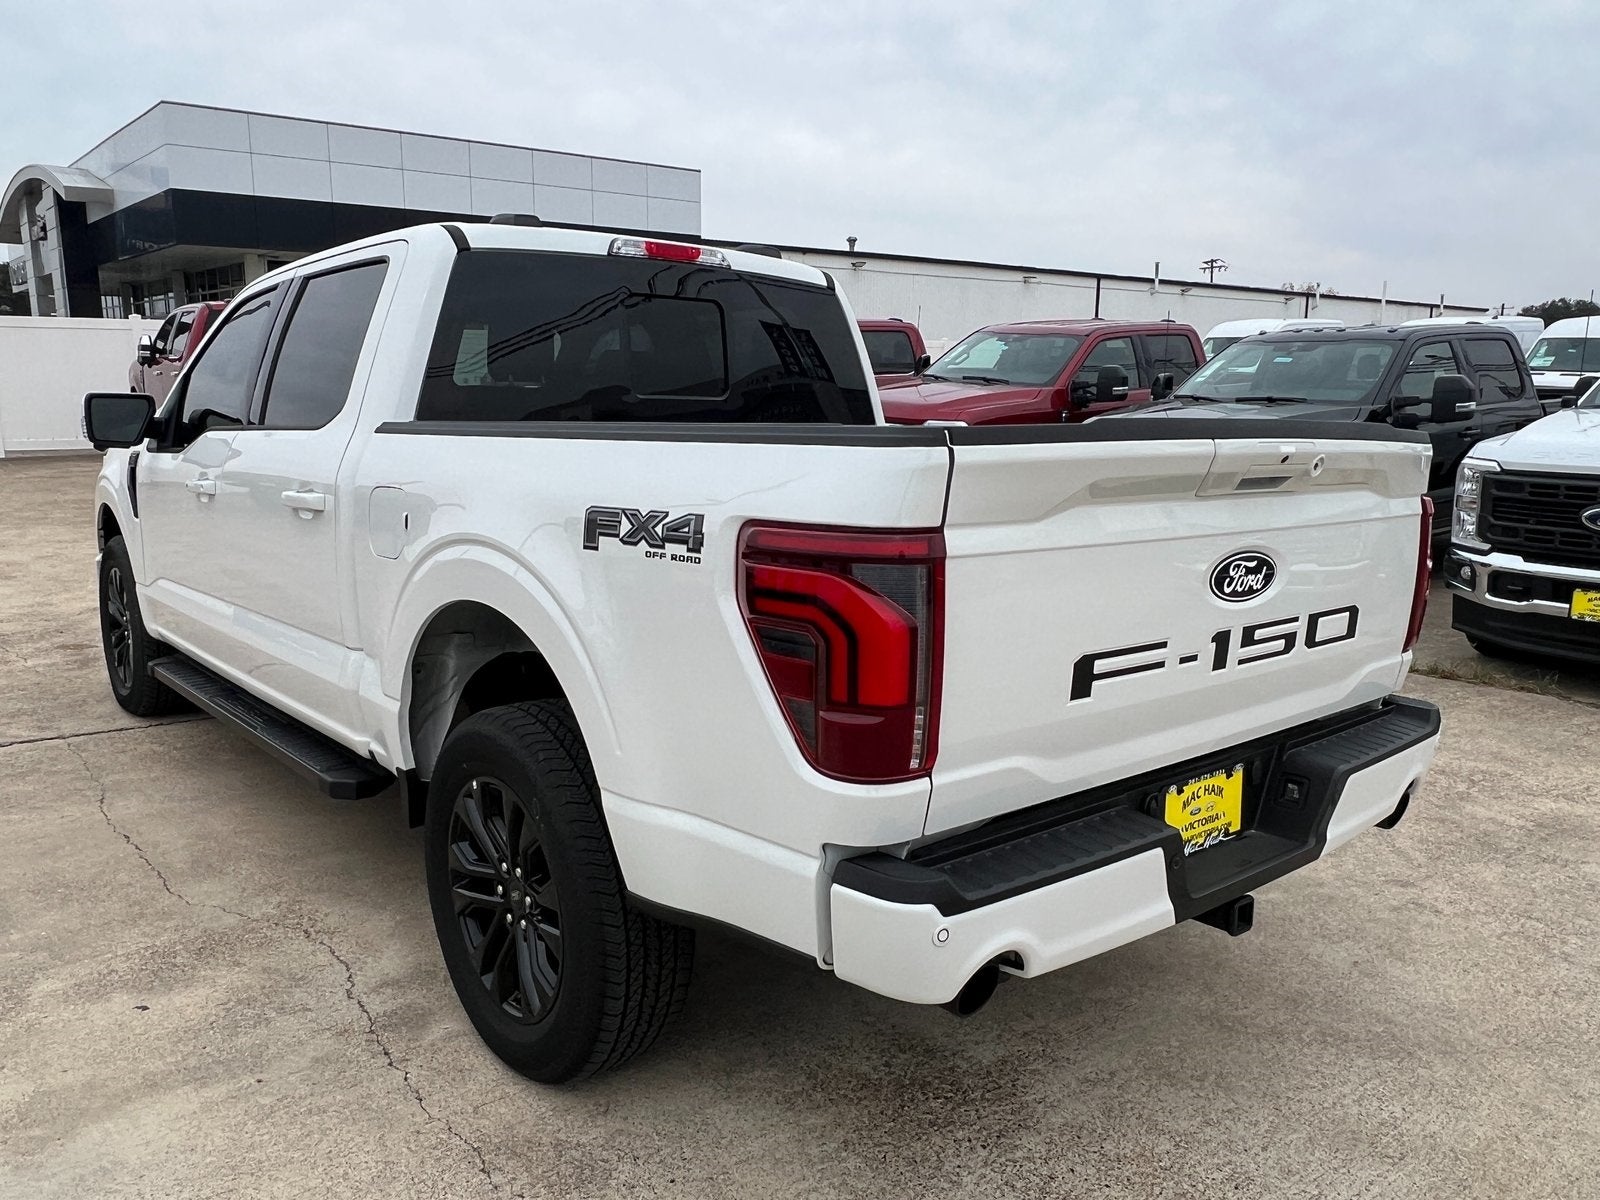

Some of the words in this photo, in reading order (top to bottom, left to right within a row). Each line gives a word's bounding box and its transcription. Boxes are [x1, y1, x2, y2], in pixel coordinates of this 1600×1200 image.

[583, 505, 705, 554] FX4
[645, 550, 666, 560] OFF
[670, 553, 701, 565] ROAD
[1069, 604, 1360, 702] F-150
[1181, 786, 1202, 813] MAC
[1203, 784, 1225, 799] HAIK
